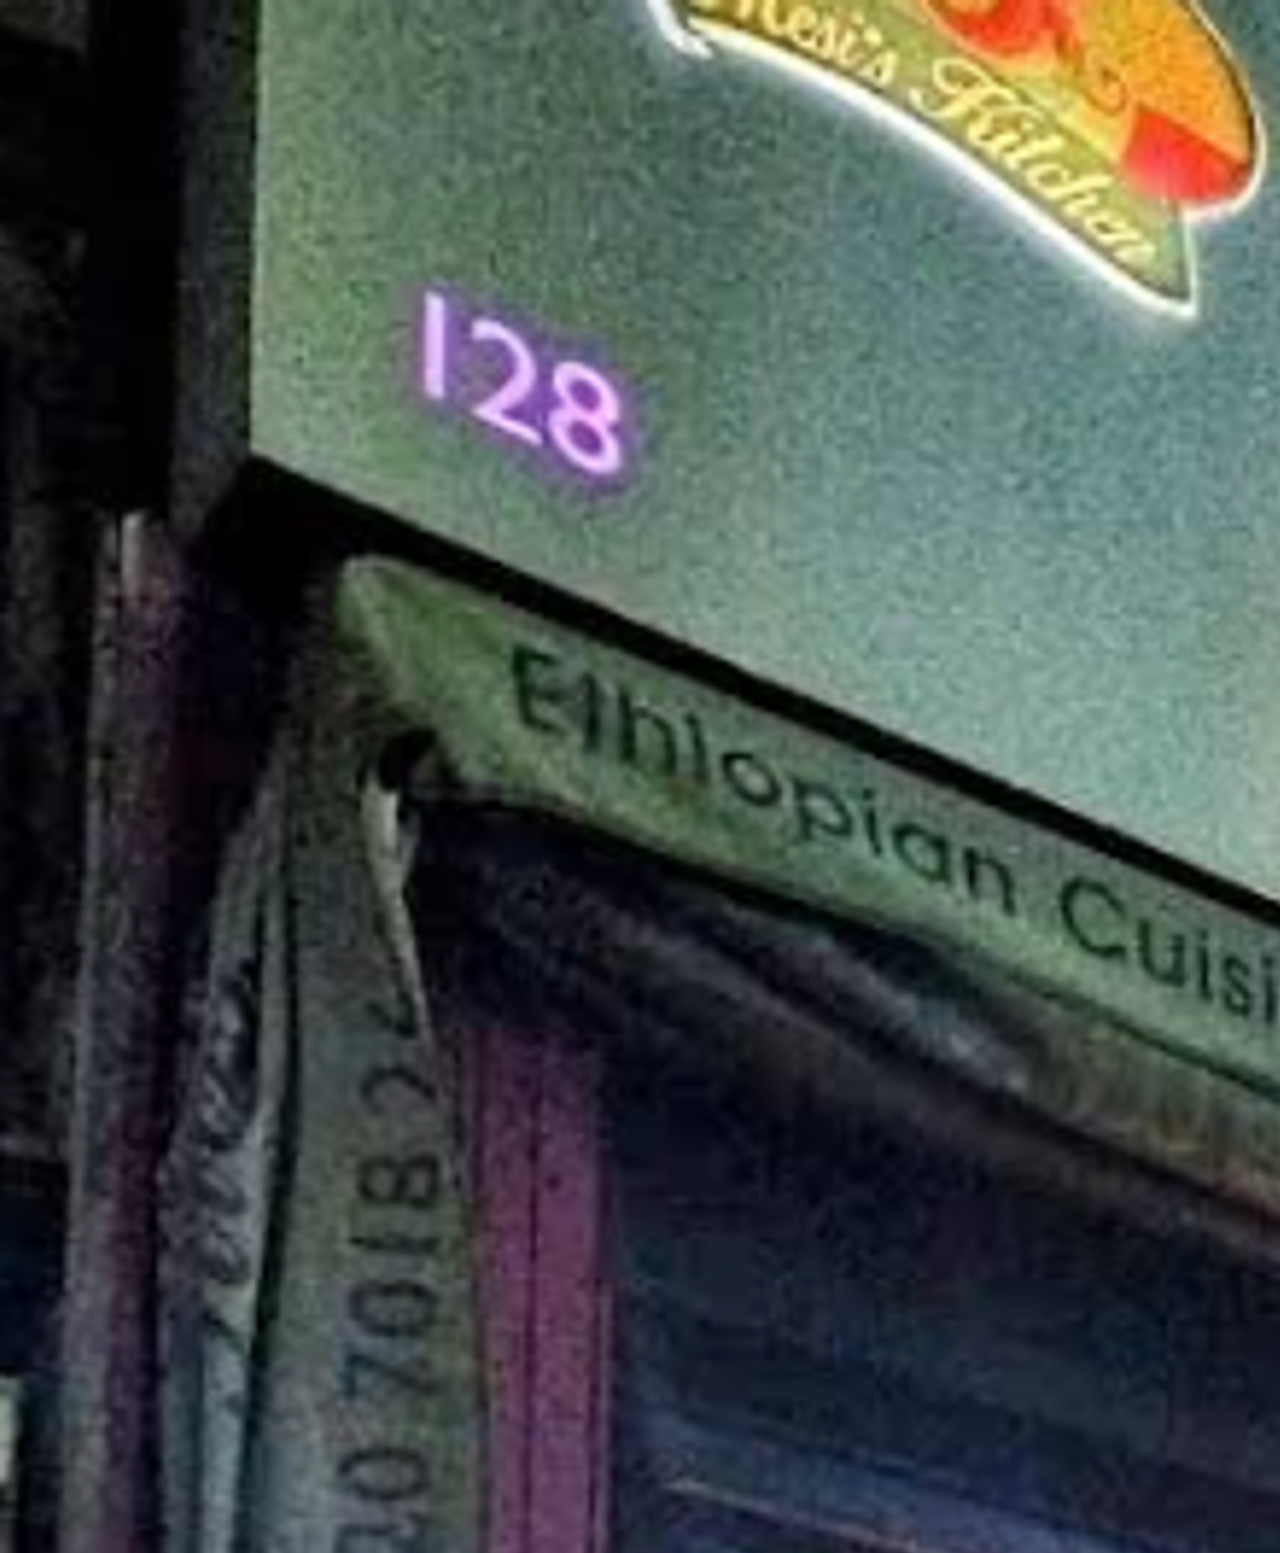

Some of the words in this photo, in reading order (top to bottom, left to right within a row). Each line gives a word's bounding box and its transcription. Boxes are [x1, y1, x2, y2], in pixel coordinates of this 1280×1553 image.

[690, 0, 900, 87] esi's
[909, 55, 1156, 260] Kitchen
[420, 292, 622, 476] 128
[510, 643, 1017, 920] Ethiopian
[337, 1150, 443, 1404] 7018
